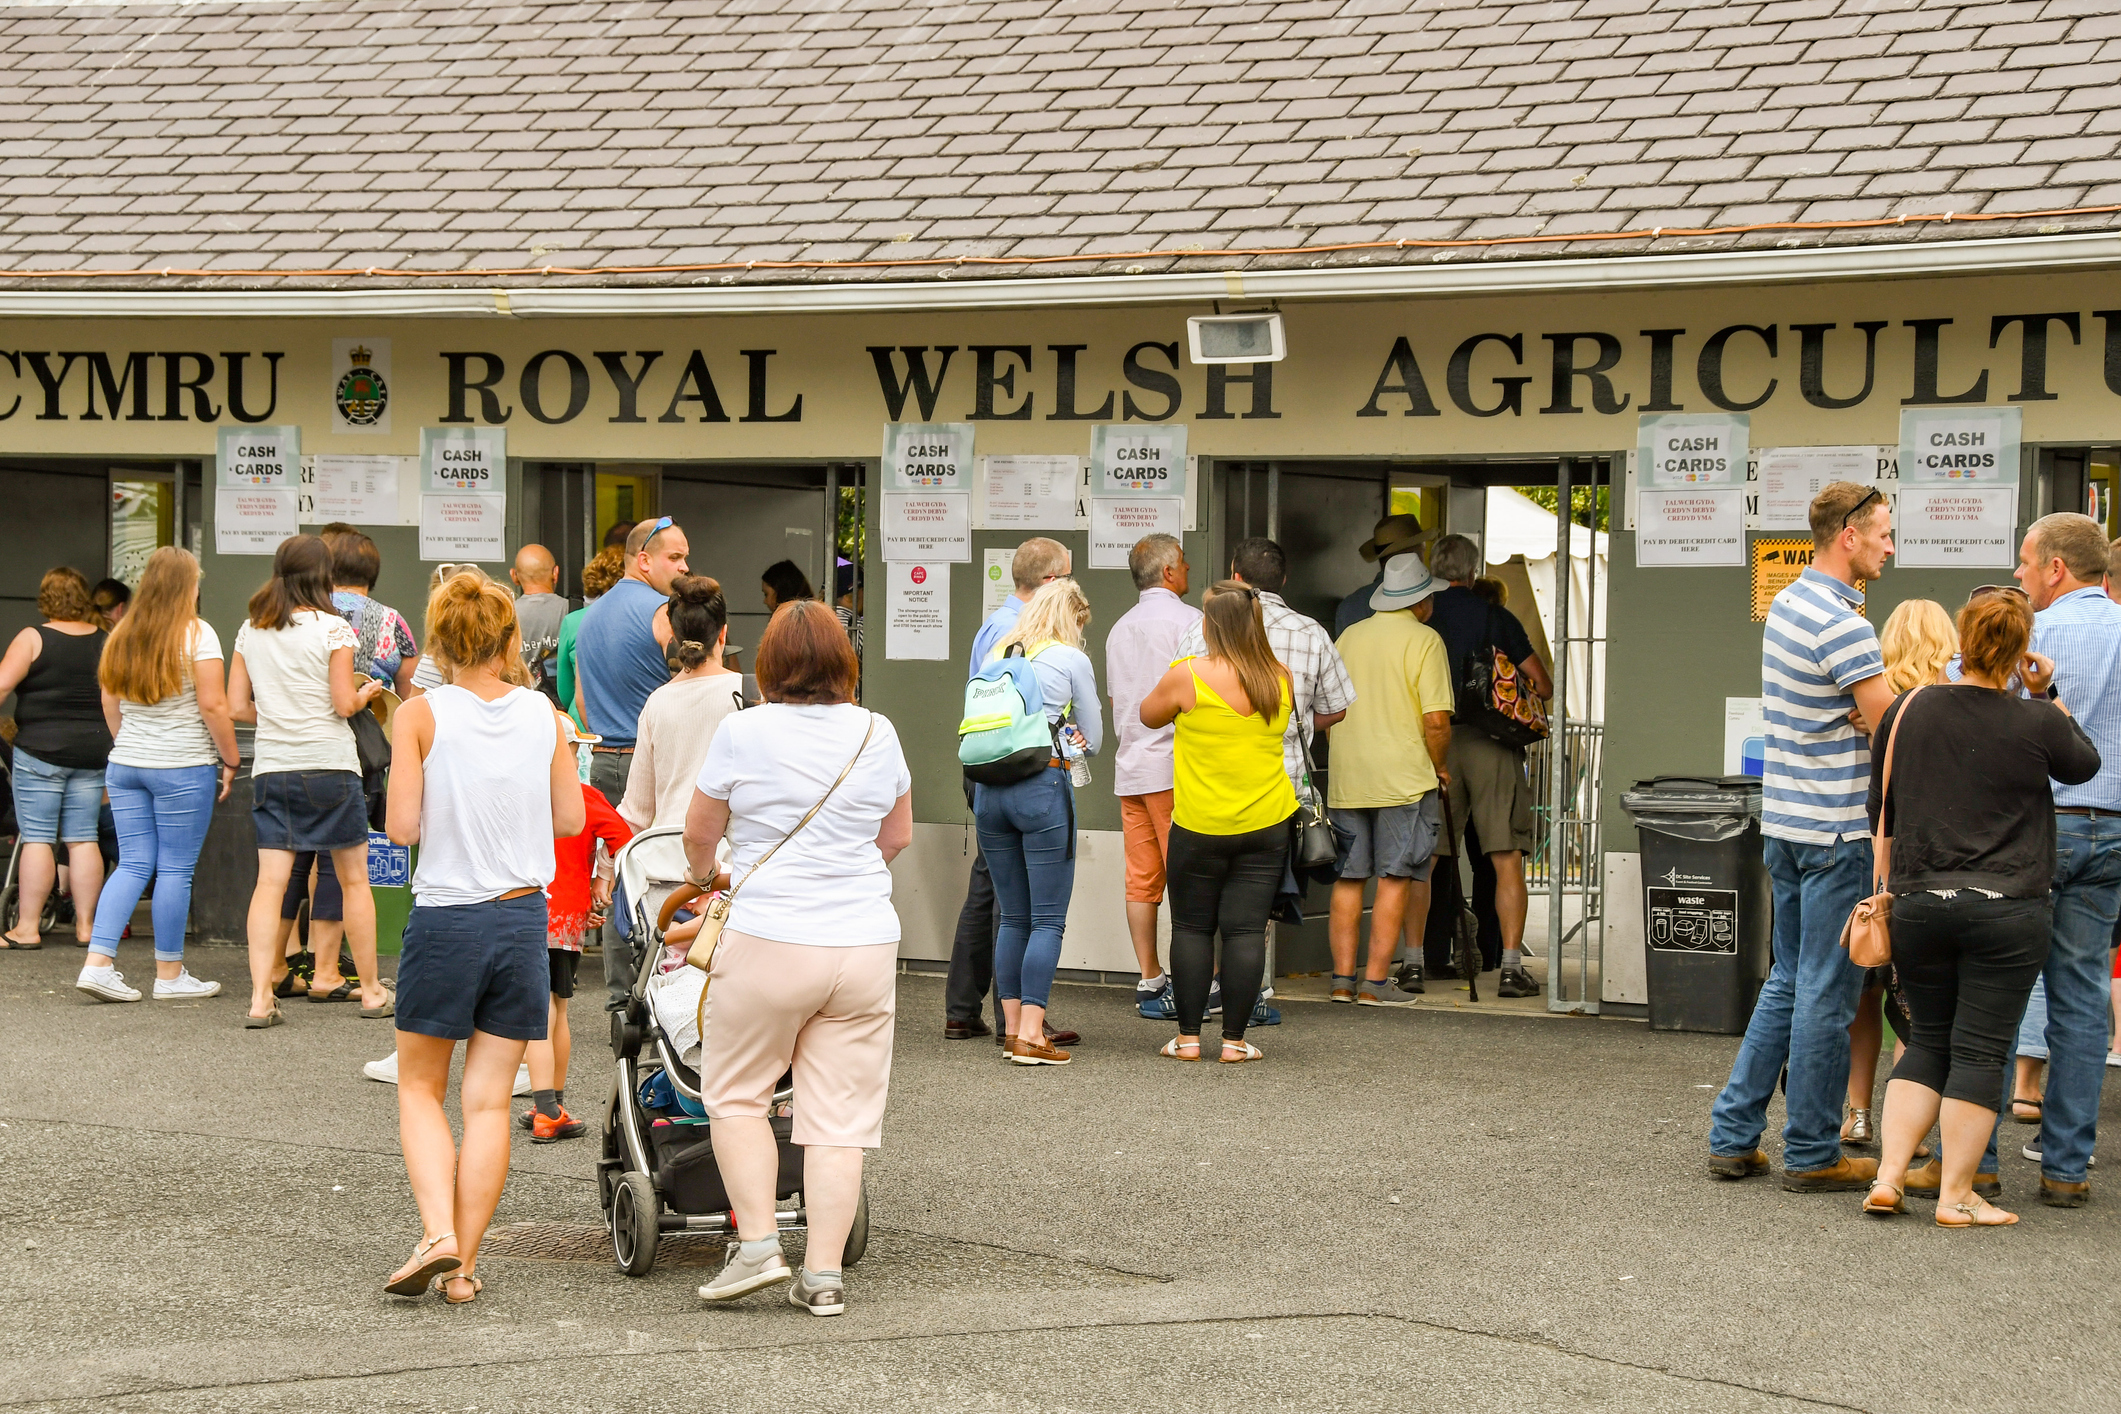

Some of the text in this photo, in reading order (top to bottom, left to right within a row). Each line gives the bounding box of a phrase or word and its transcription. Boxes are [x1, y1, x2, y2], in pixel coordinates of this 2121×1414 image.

[439, 349, 803, 424] ROYAL
[866, 341, 1282, 421] WELSH
[1356, 310, 2121, 416] AGRICULT
[1668, 437, 1718, 451] CASH
[1930, 432, 1985, 446] CASH
[238, 447, 276, 457] CASH
[443, 450, 481, 461] CASH
[908, 445, 948, 457] CASH
[1117, 448, 1160, 460] CASH
[1665, 458, 1727, 472] CARDS
[1926, 454, 1994, 468] CARDS
[235, 464, 283, 475] CARDS
[441, 468, 489, 479] CARDS
[905, 464, 956, 476] CARDS
[1114, 467, 1168, 479] CARDS
